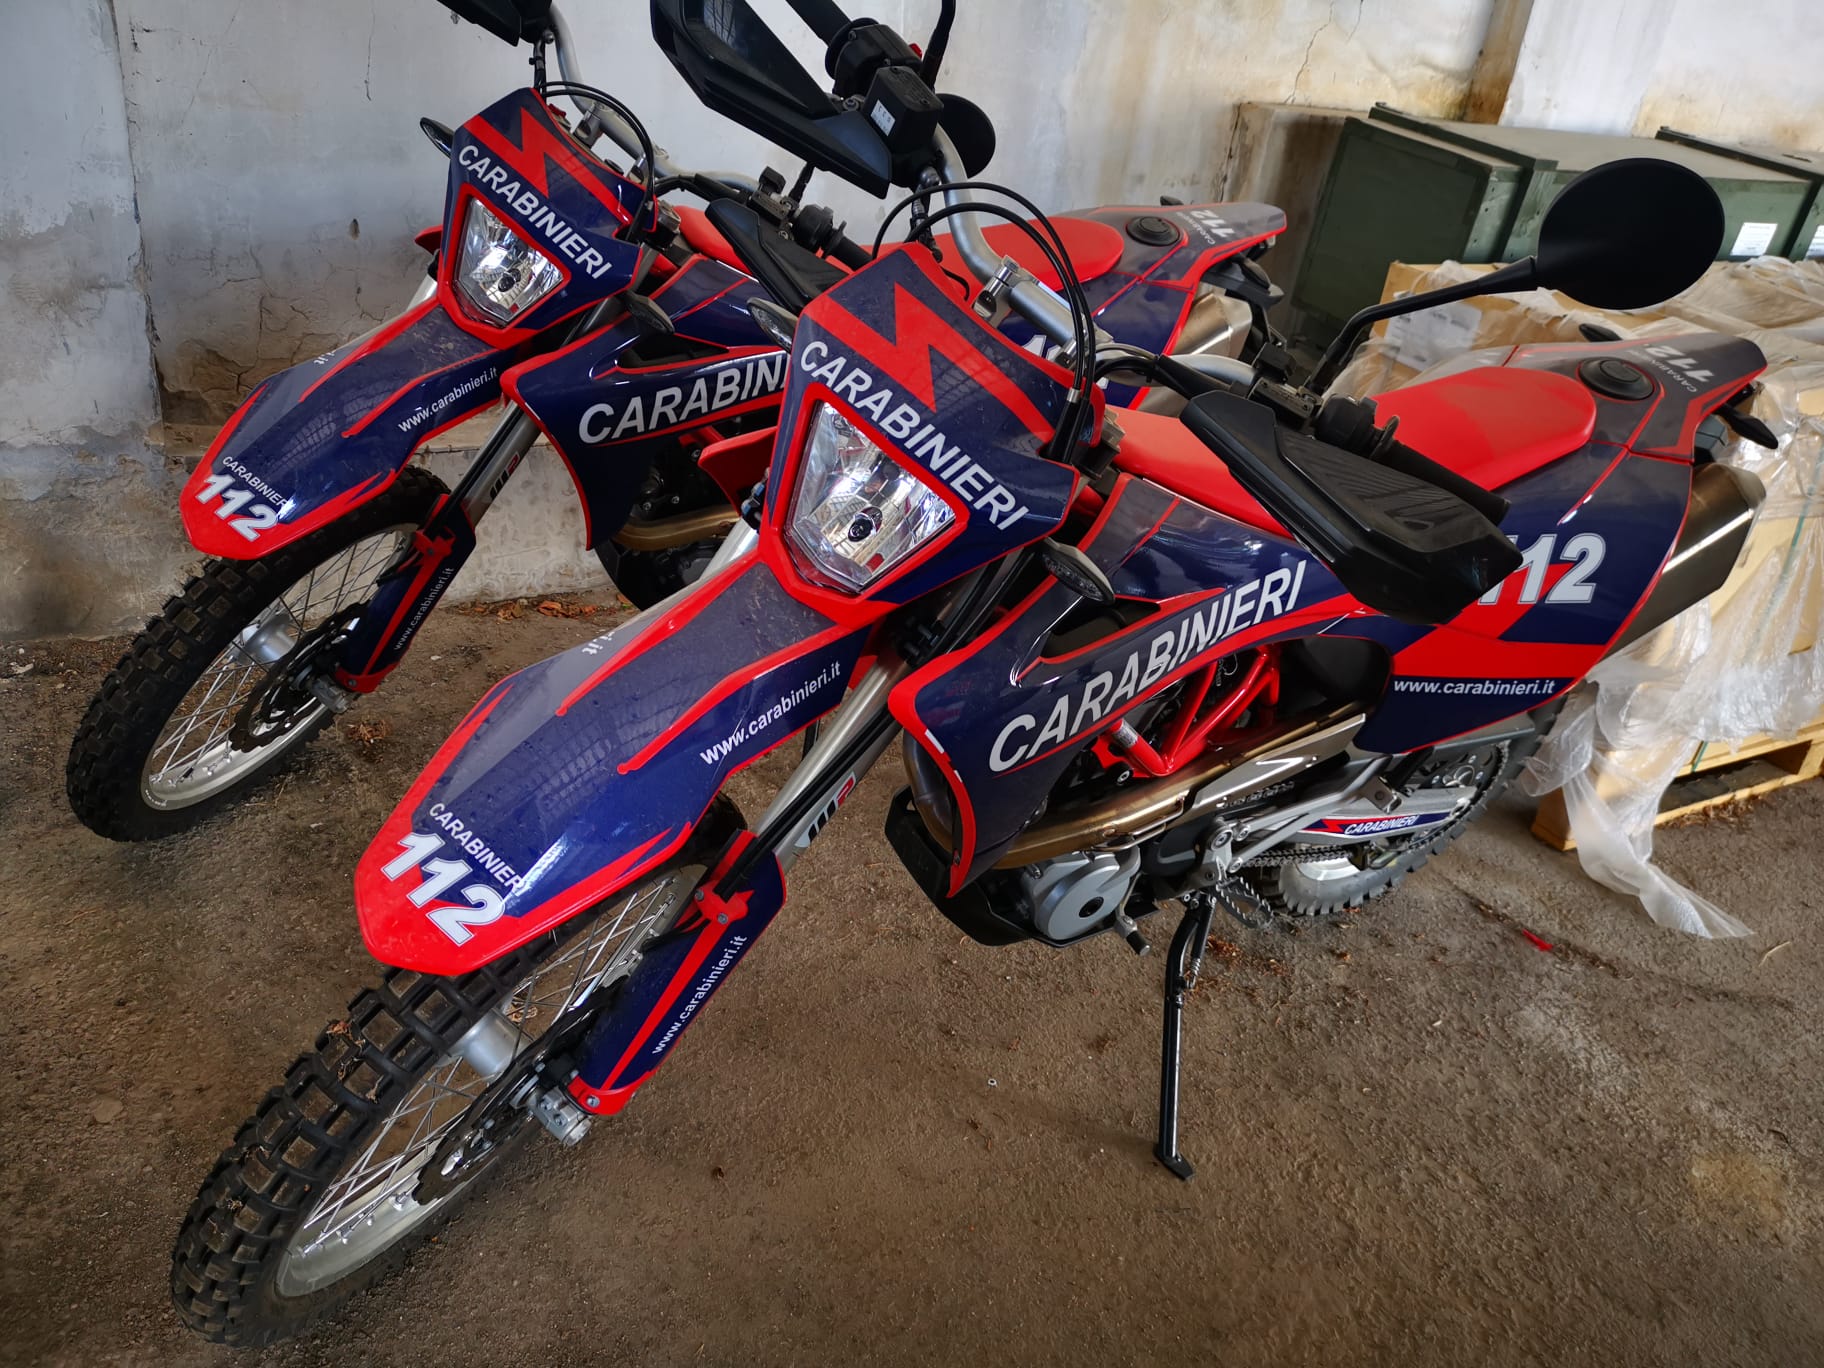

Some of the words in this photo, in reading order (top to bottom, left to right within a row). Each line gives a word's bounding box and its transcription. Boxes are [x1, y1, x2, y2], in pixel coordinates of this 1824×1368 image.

[459, 145, 612, 279] CARABINIERI
[398, 367, 497, 432] www.carabinieri.it
[1645, 346, 1714, 382] 112
[800, 341, 1029, 530] CARABINIERI
[194, 474, 278, 542] 112
[394, 567, 454, 651] www.carabinieri.it
[700, 660, 841, 765] www.carabinieri.it
[989, 560, 1306, 773] CARABINIERI
[1393, 680, 1556, 696] www.carabinieri.it
[1344, 815, 1420, 835] CARABINIERI
[380, 831, 506, 947] 112
[652, 935, 748, 1054] www.carabinieri.it
